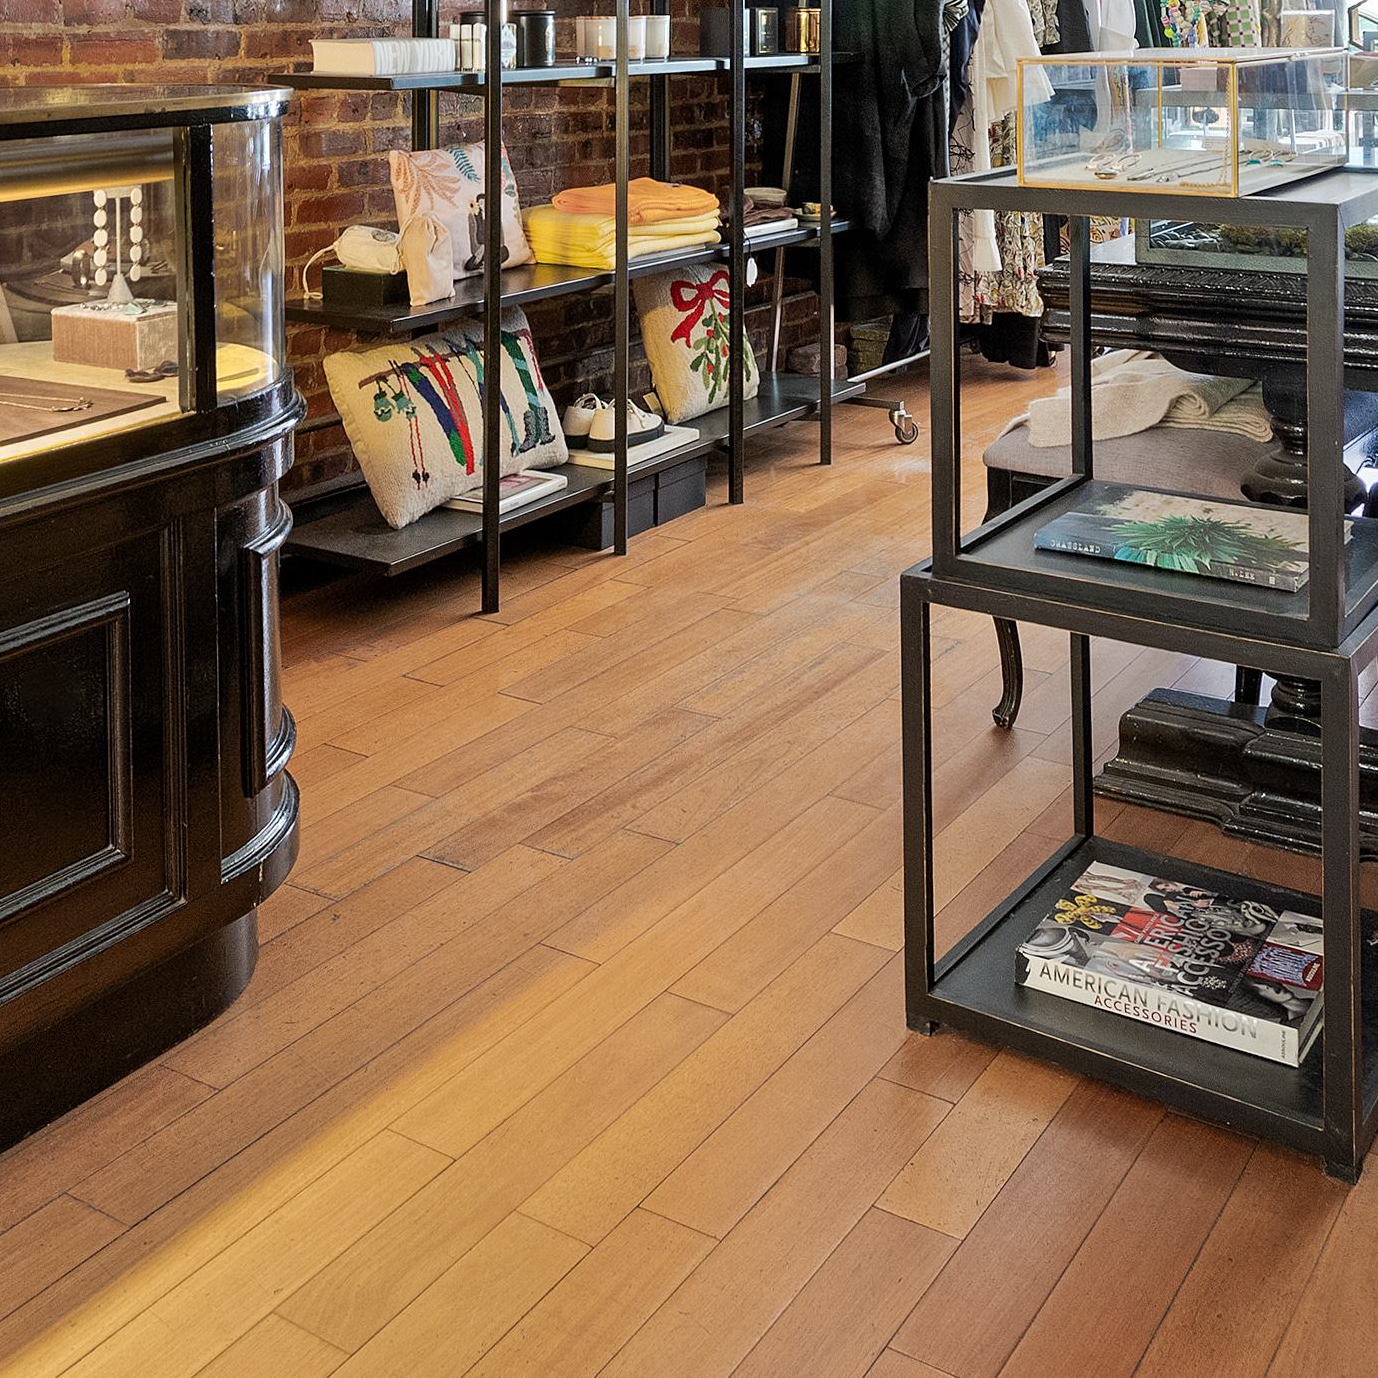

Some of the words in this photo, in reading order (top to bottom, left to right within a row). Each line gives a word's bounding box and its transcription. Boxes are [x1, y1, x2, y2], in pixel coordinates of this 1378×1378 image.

[414, 39, 456, 74] YORK
[1040, 962, 1148, 1008] AMERICAN
[1157, 994, 1258, 1039] FASHION
[1094, 995, 1198, 1034] ACCESSORIES
